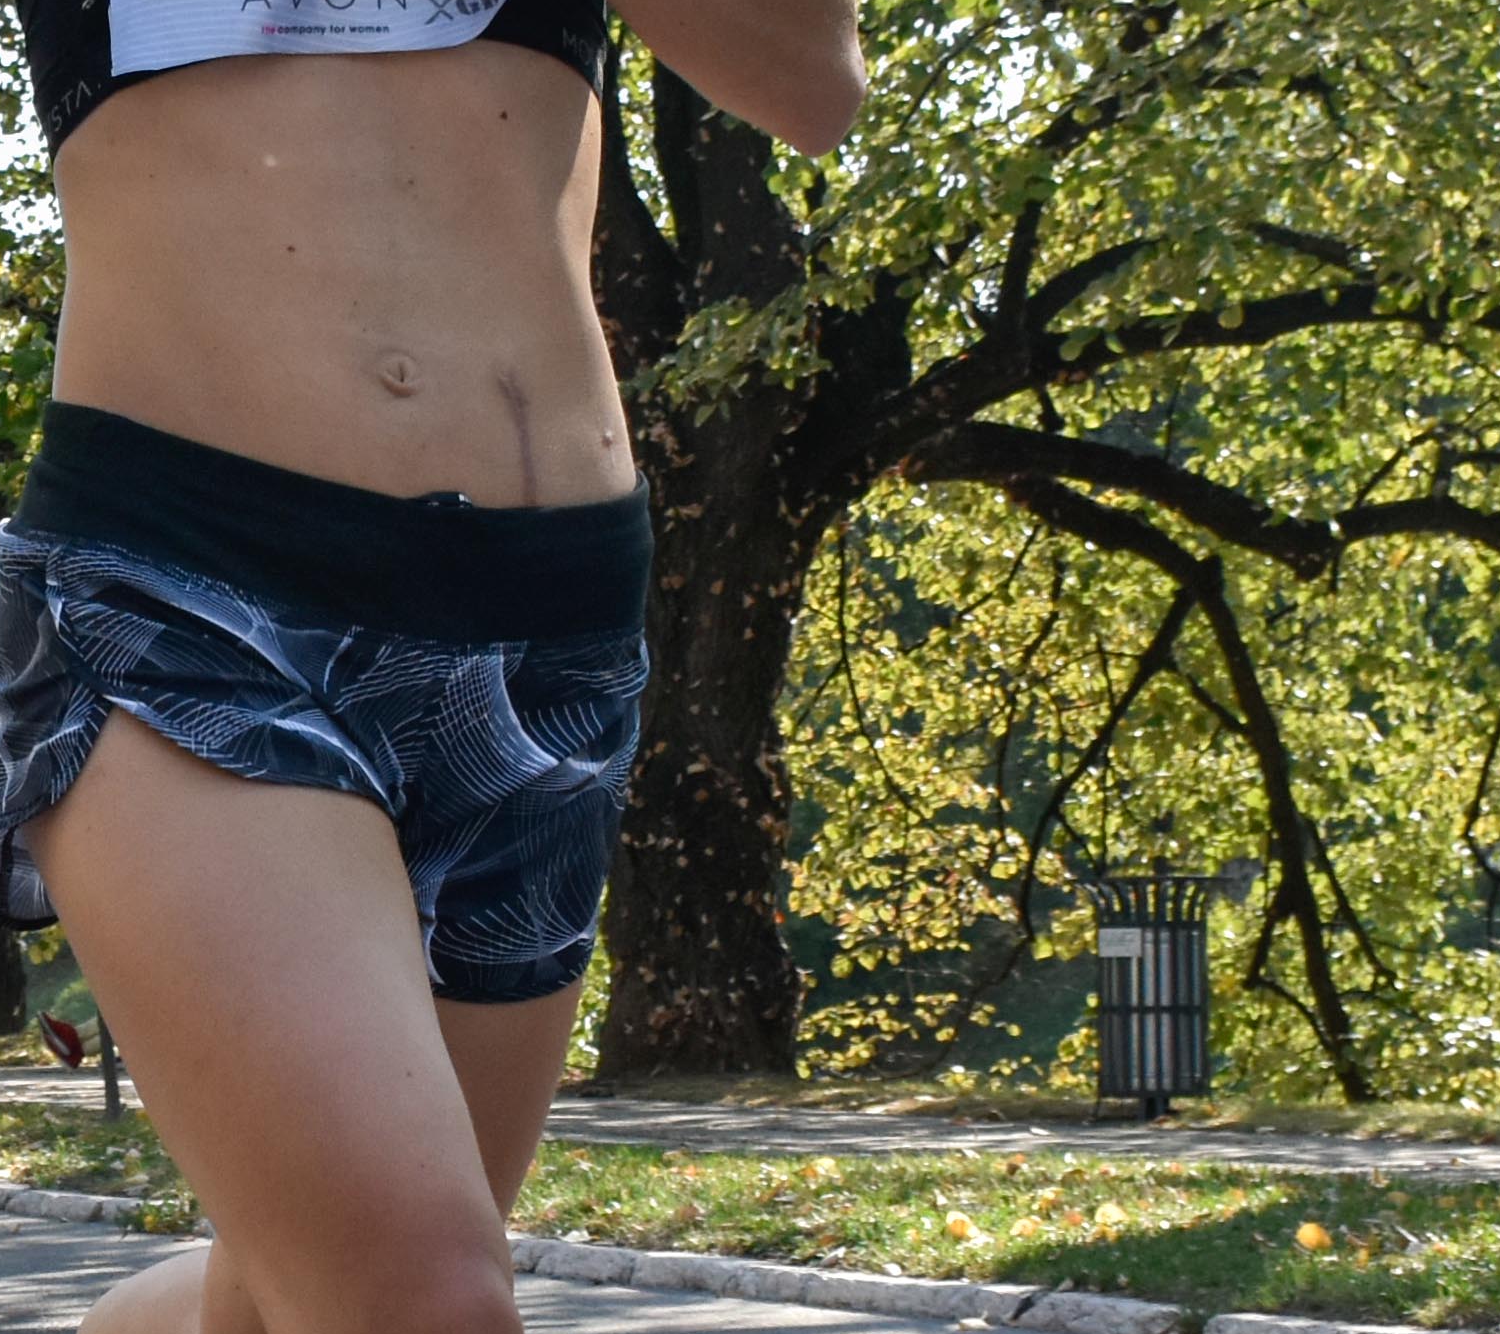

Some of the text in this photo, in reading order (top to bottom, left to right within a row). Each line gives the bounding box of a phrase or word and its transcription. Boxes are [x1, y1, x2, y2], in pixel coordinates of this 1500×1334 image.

[278, 24, 326, 35] company
[330, 23, 345, 34] for
[349, 24, 390, 34] women
